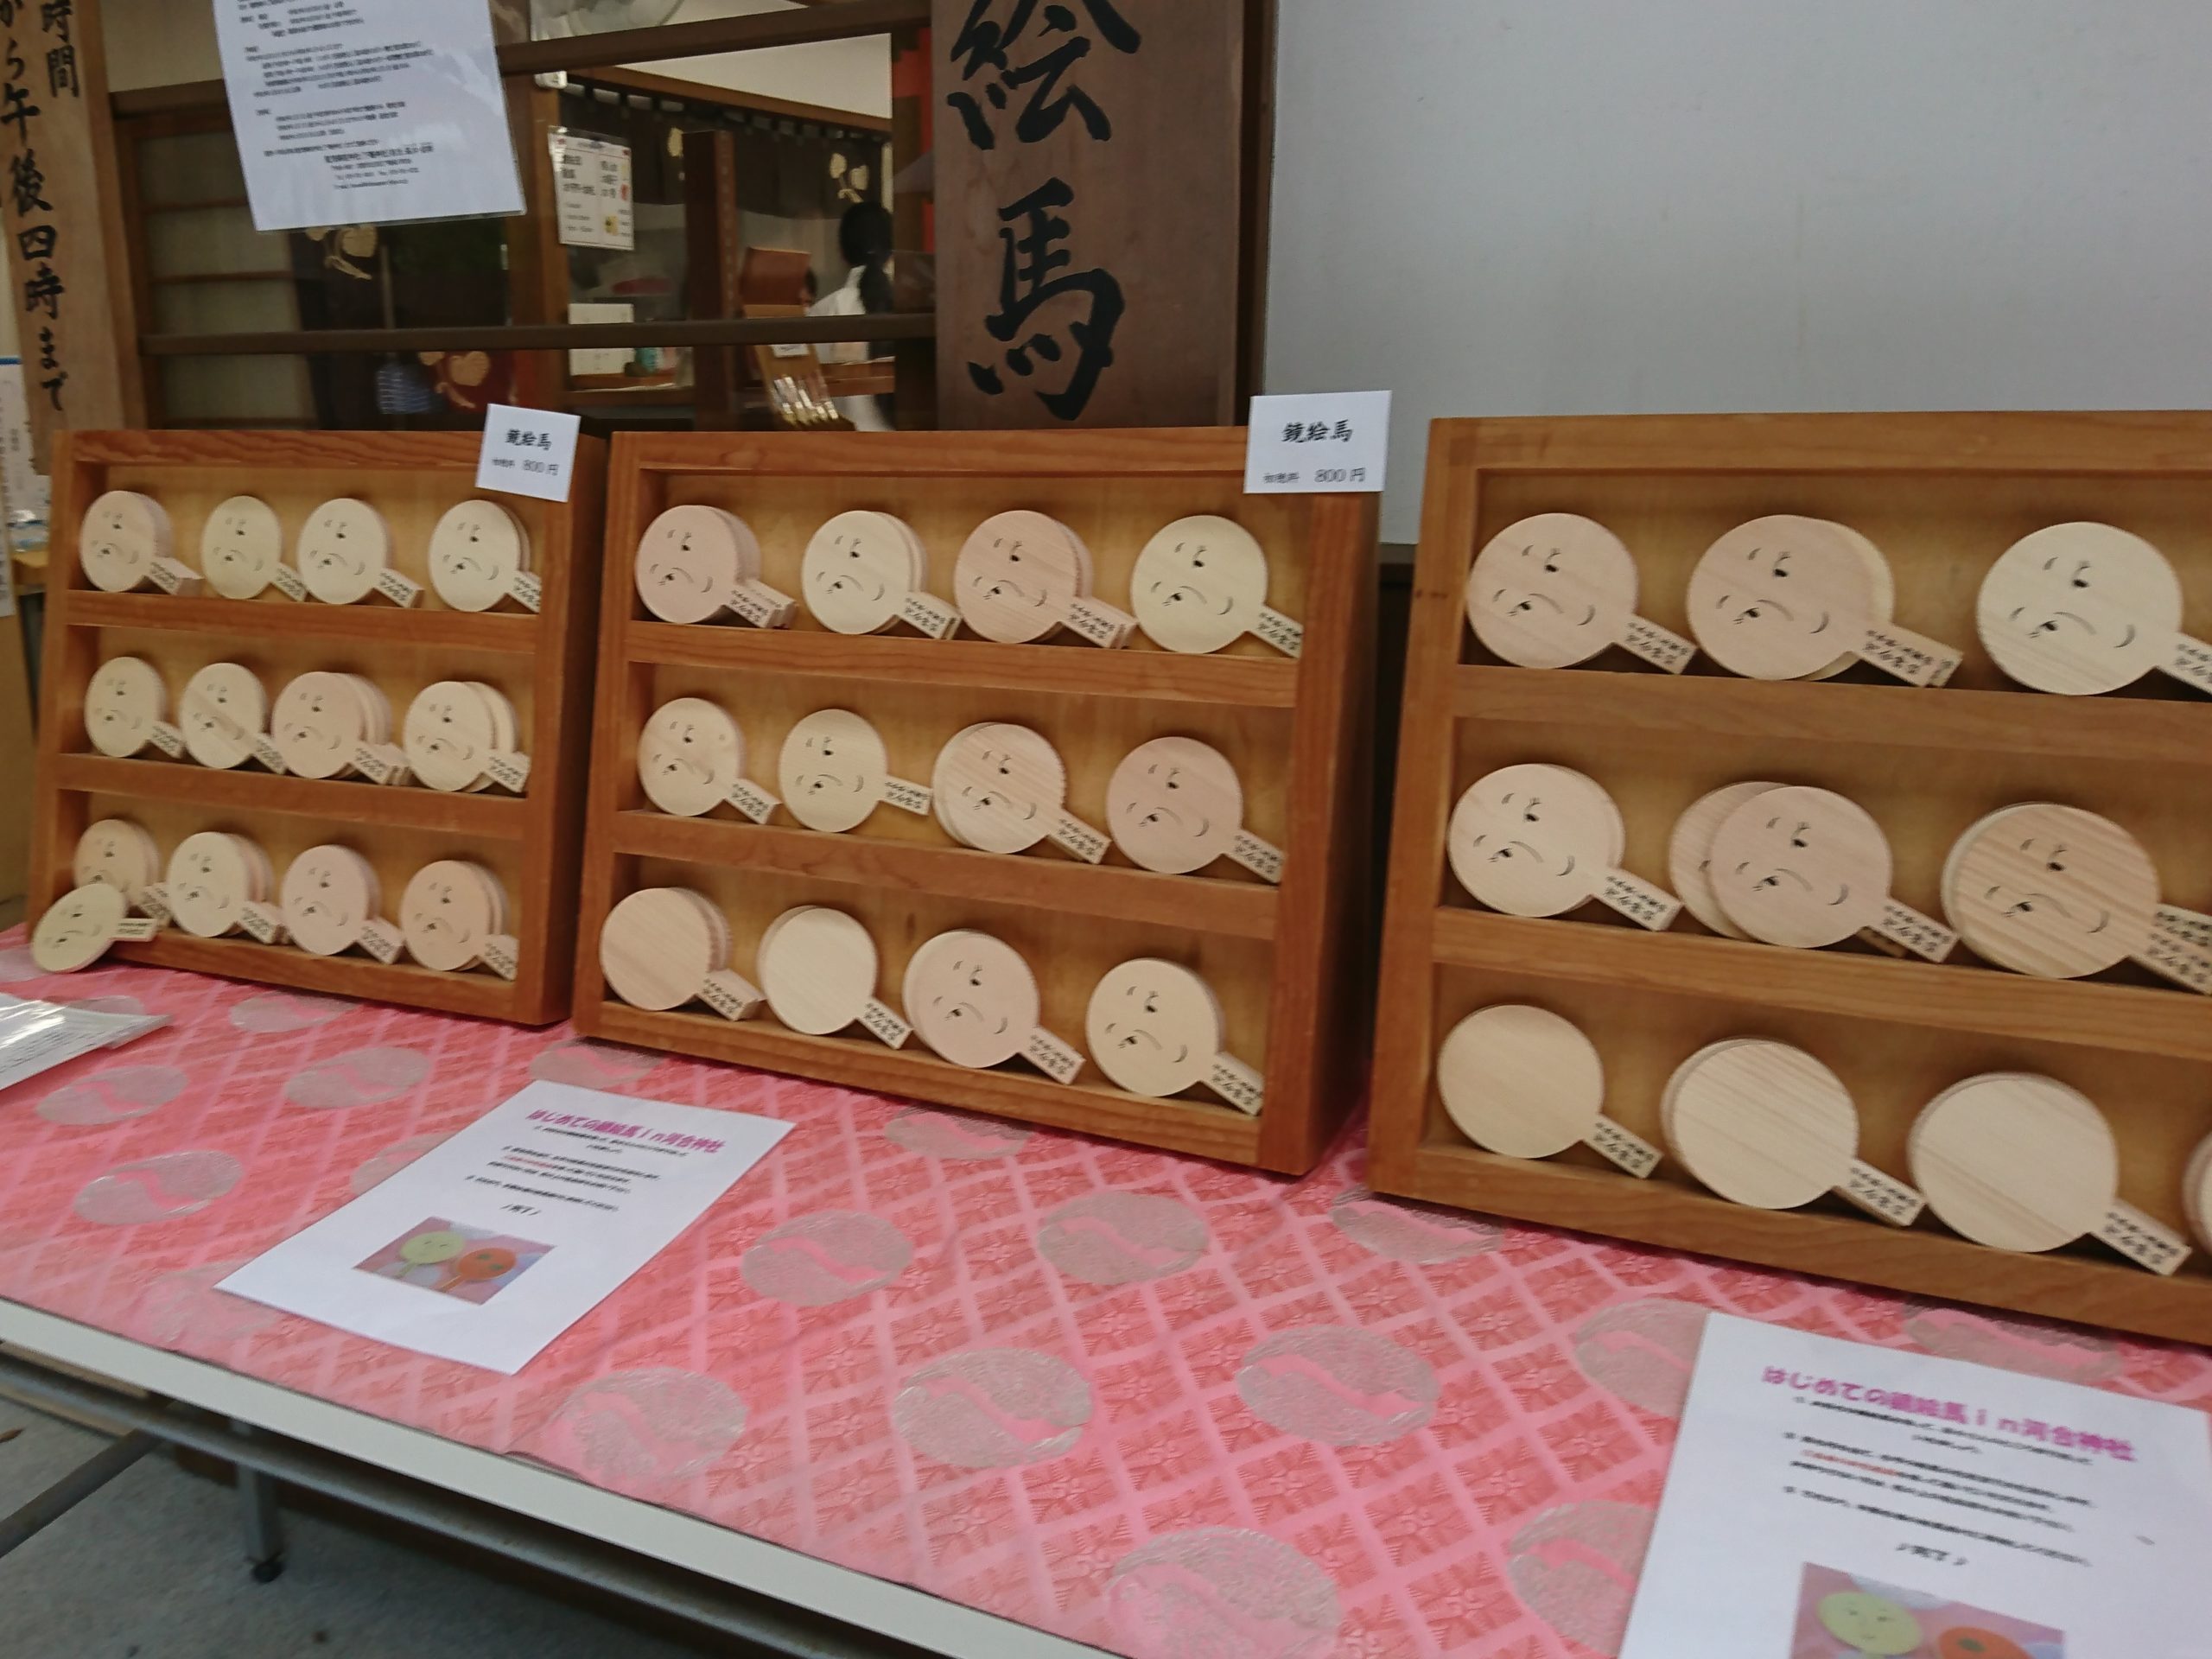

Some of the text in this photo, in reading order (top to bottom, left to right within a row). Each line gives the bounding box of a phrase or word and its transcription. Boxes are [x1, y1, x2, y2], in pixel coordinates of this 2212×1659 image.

[947, 0, 1141, 421] 絵馬
[1281, 419, 1354, 443] 鏡絵馬
